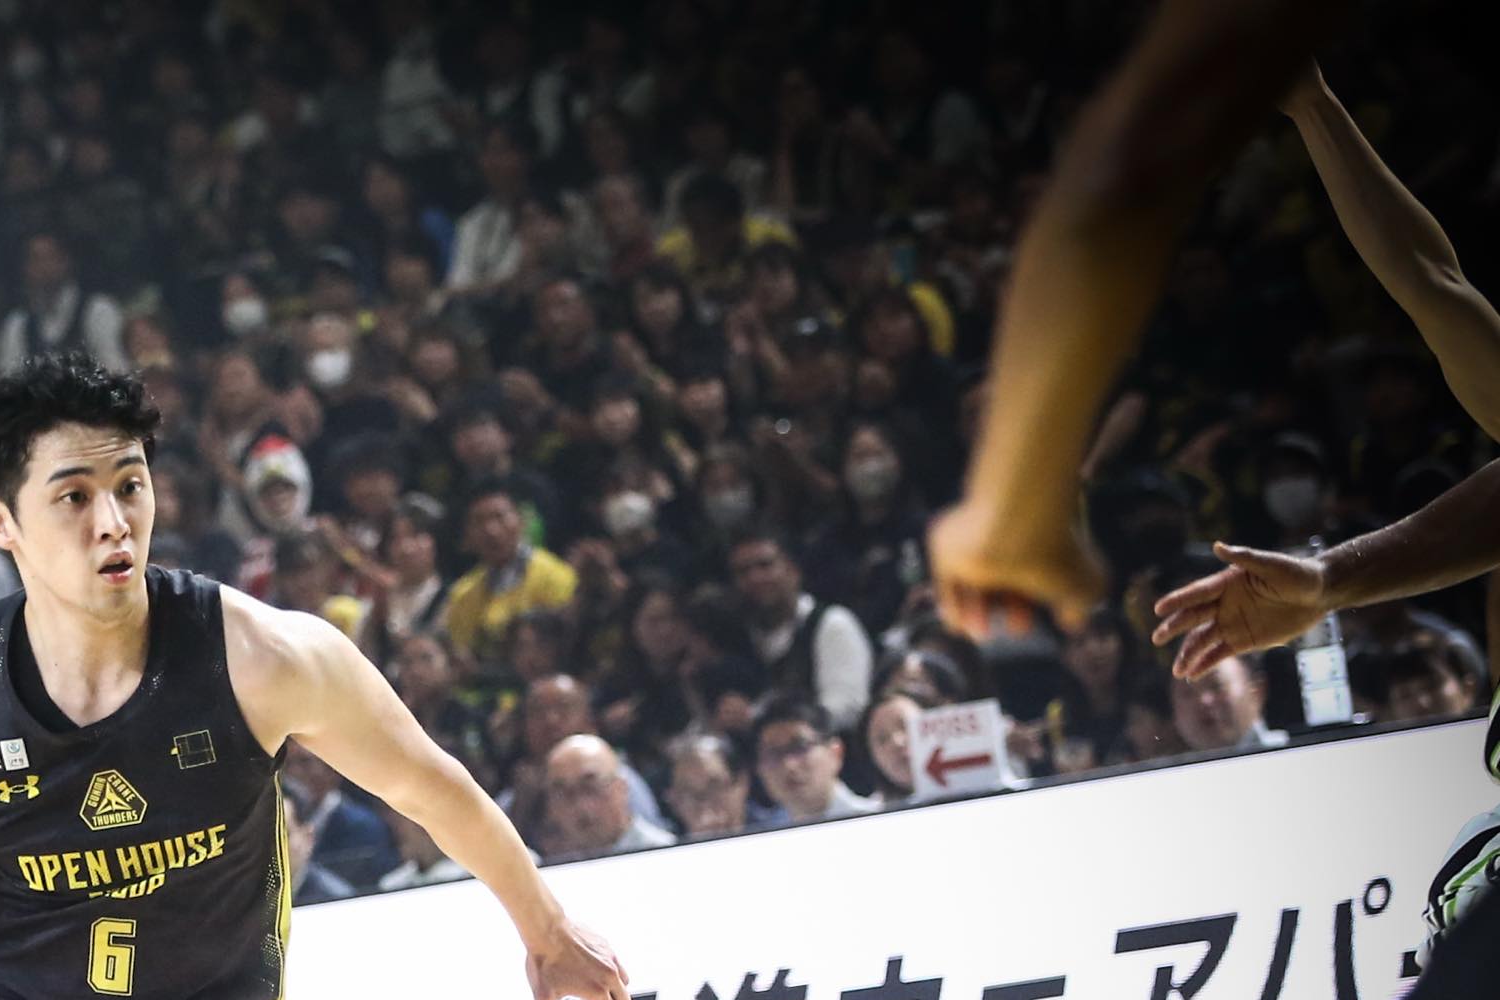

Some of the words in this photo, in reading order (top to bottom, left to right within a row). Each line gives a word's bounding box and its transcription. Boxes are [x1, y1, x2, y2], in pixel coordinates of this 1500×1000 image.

[107, 774, 136, 802] CRANE
[92, 810, 138, 827] THUNDERS
[17, 849, 113, 892] OPEN
[115, 824, 228, 881] HOUSE
[89, 873, 166, 899] OUP
[86, 917, 137, 996] 6
